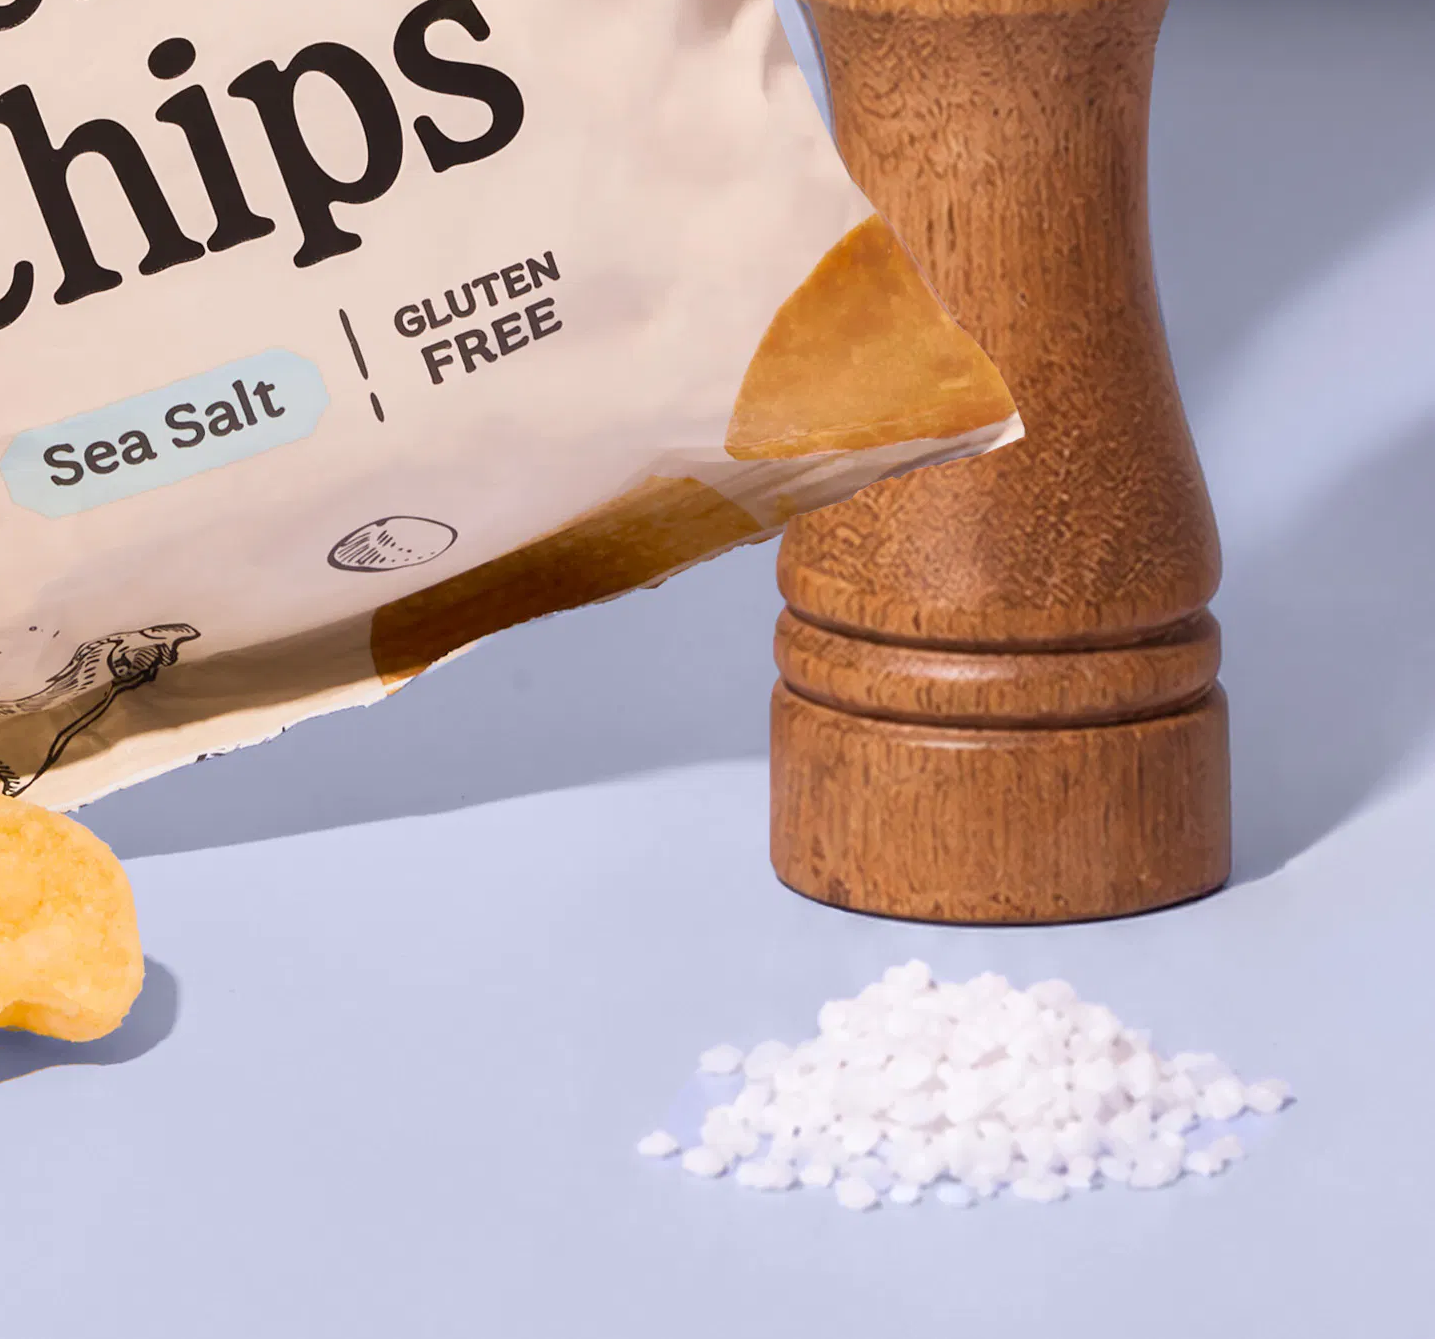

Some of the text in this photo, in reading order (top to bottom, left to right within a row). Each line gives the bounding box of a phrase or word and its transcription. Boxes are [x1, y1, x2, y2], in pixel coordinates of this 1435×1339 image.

[393, 250, 561, 339] GLUTEN
[420, 296, 564, 386] FREE
[43, 379, 286, 487] Sea Salt
